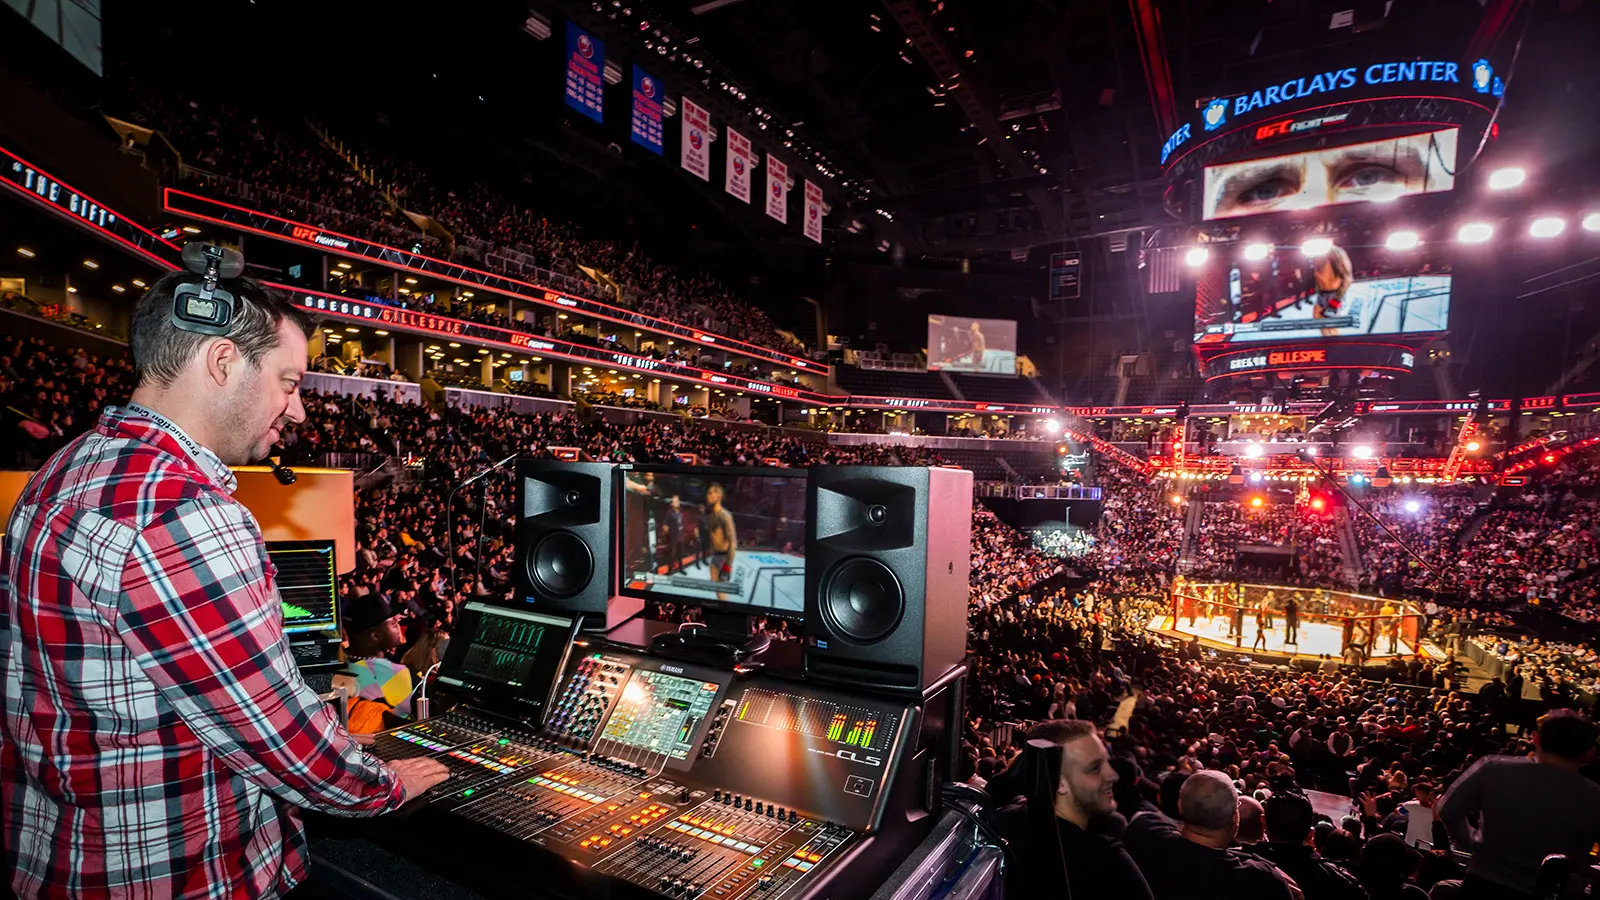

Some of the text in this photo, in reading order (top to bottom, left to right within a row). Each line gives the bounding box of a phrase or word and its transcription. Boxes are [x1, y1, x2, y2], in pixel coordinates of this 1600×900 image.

[1233, 61, 1460, 117] BARCLAYS CENTER
[1256, 119, 1294, 139] UFC
[13, 162, 116, 227] "THE GIFT"
[292, 226, 318, 241] UFC
[315, 235, 335, 247] FIGHT
[304, 296, 461, 334] GREGOR GILLESPIE
[511, 334, 531, 346] UFC
[1268, 349, 1327, 365] GILLESPIE
[129, 405, 200, 457] Production Crew
